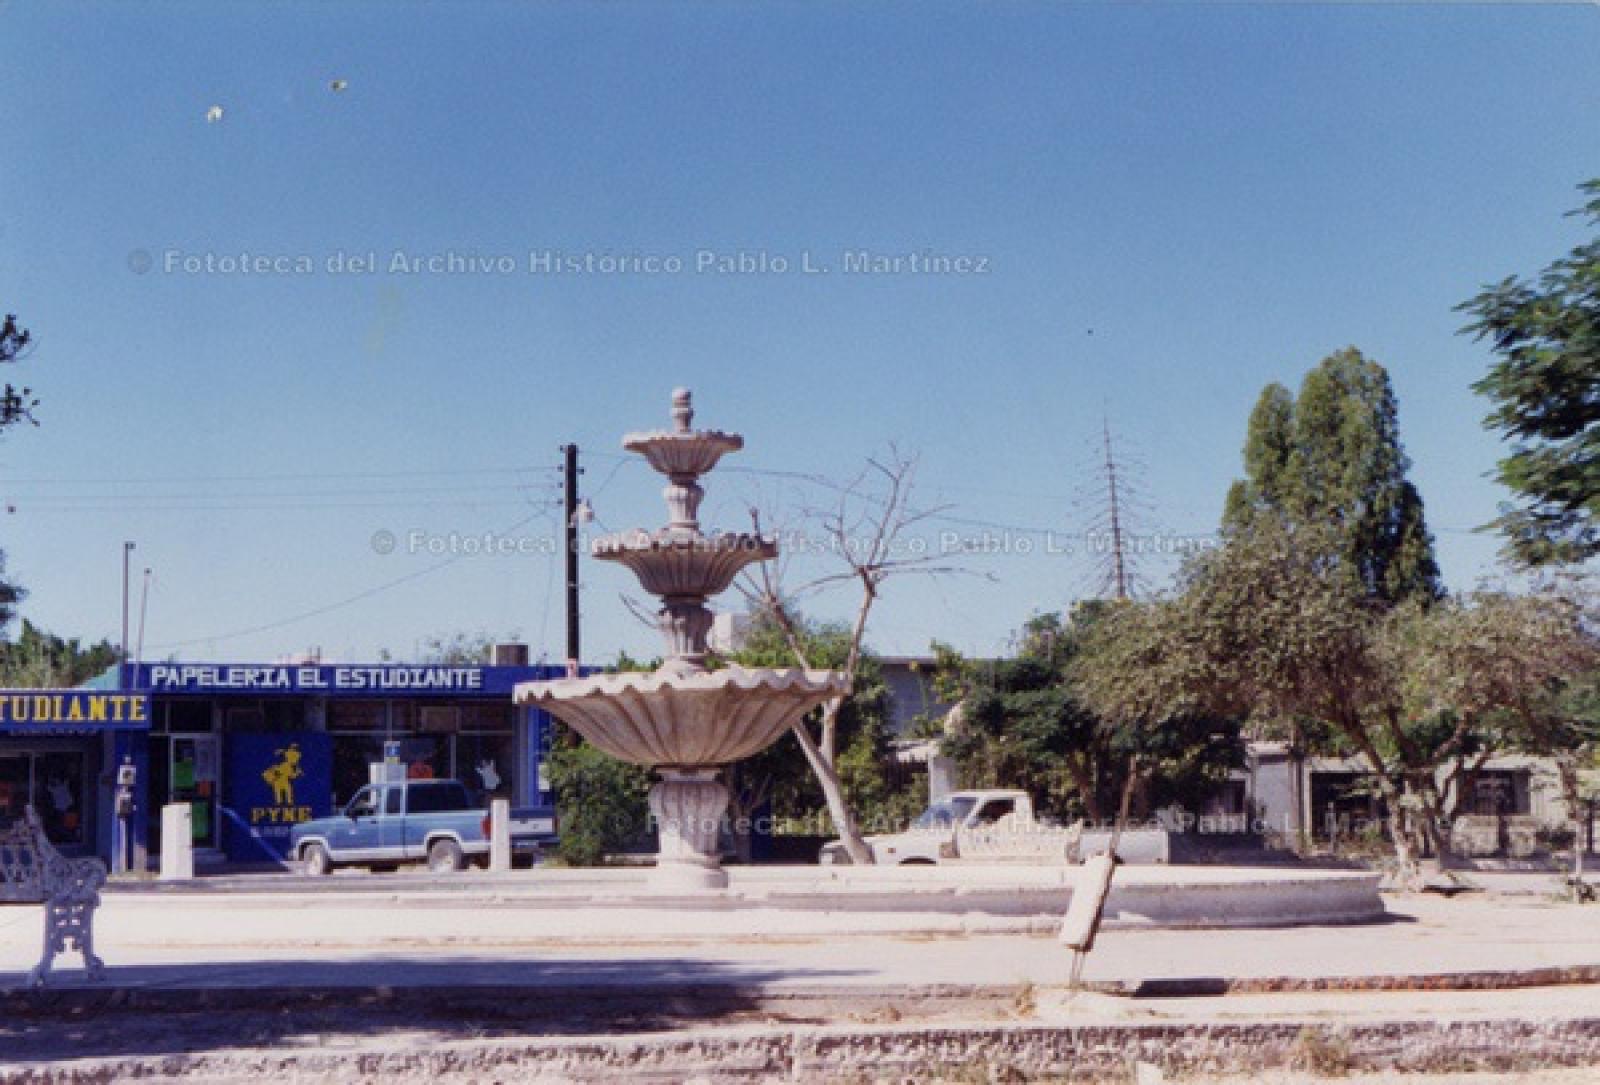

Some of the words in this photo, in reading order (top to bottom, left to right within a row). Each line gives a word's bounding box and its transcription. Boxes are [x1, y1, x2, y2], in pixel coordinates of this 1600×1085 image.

[152, 667, 291, 688] PAPELERIA
[298, 667, 328, 688] EL
[336, 667, 481, 688] ESTUDIANTE
